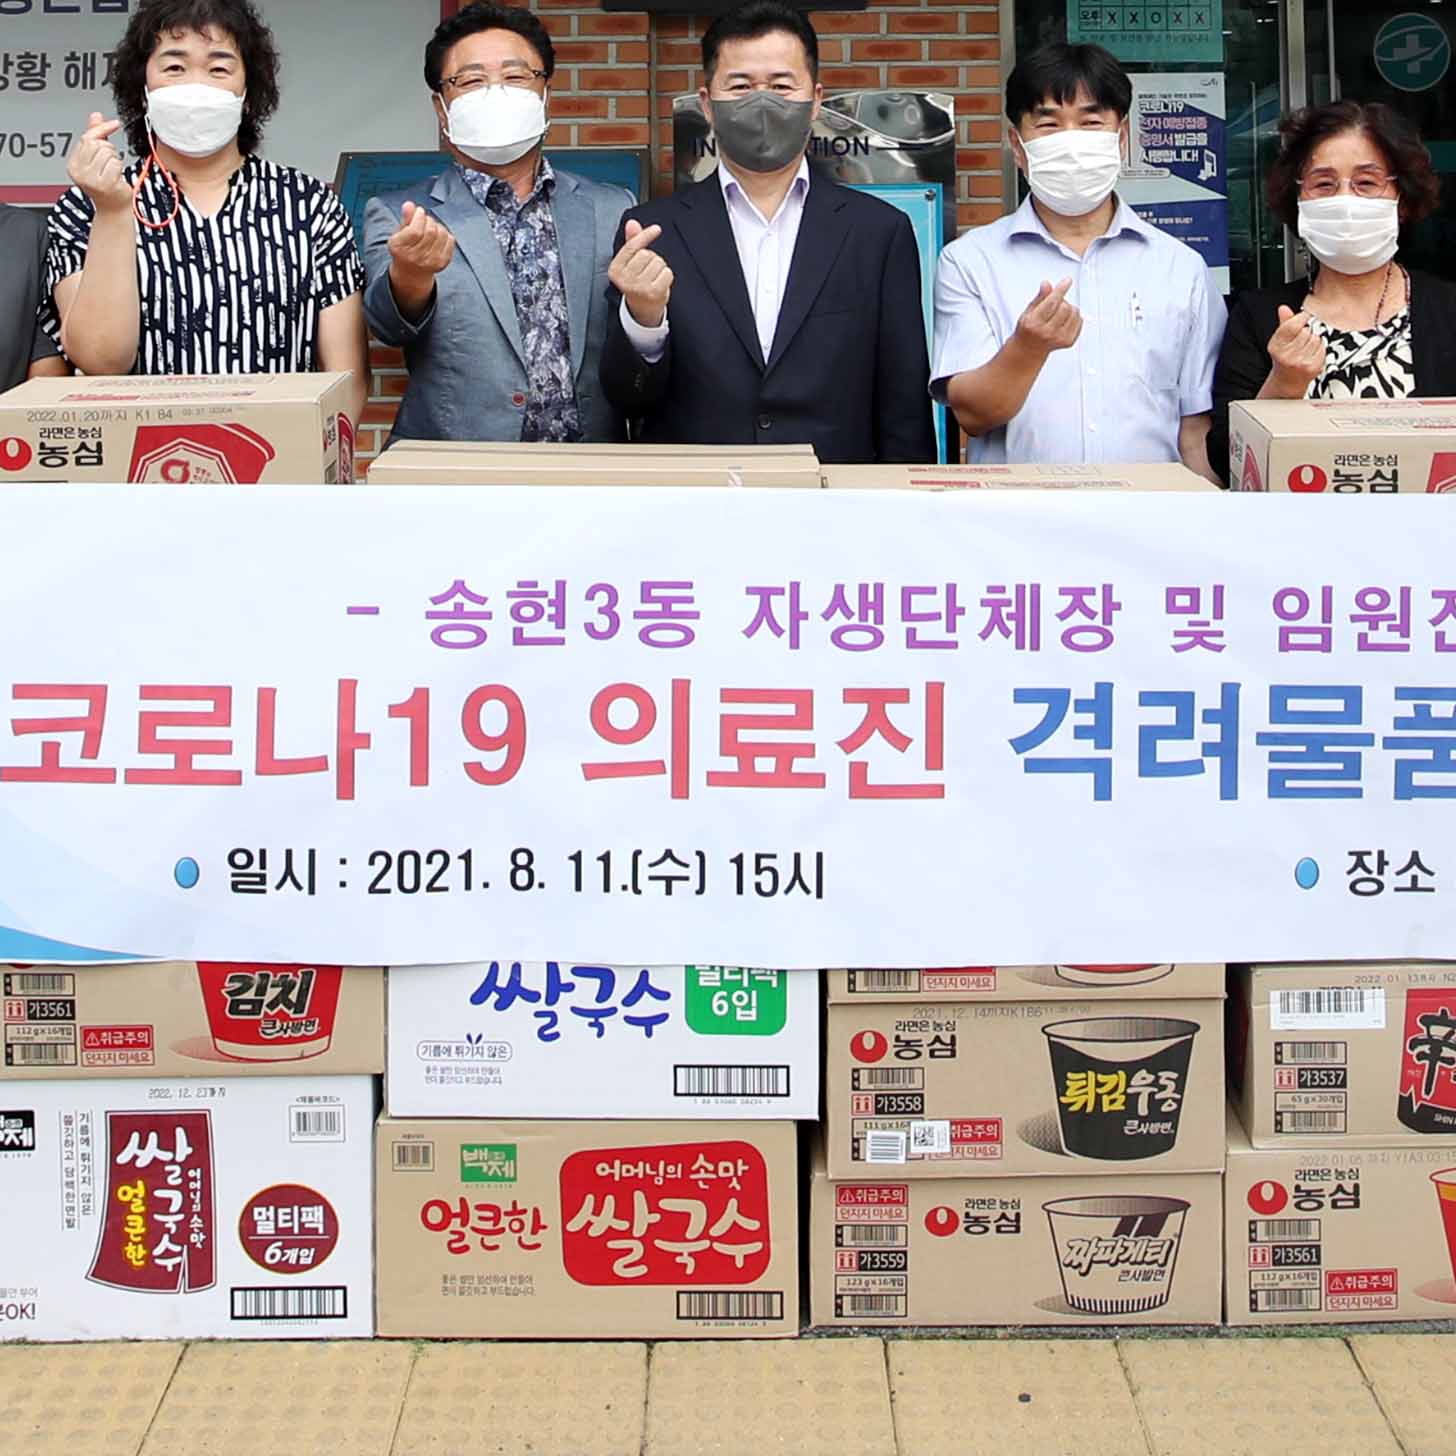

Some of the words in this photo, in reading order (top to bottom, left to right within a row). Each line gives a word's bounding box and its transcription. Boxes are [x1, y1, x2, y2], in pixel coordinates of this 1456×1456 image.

[693, 136, 869, 158] INTION
[37, 440, 104, 468] 농심
[424, 576, 702, 651] 송현3동
[742, 579, 1122, 653] 자생단체장
[1168, 583, 1227, 652] 및
[581, 677, 947, 801] 의료진
[226, 847, 319, 898] 일시
[367, 851, 491, 898] 2021.
[510, 849, 546, 892] 8.
[729, 849, 828, 901] 15시
[1345, 851, 1436, 898] 장소
[29, 1001, 73, 1019] 가3561
[223, 969, 317, 1019] 김치
[470, 961, 672, 1042] 쌀국수
[892, 1033, 957, 1060] 농심
[1060, 1069, 1184, 1114] 튀김우동
[1299, 1068, 1345, 1087] 가3537
[876, 1095, 923, 1113] 가3558
[595, 1159, 682, 1186] 어머님의
[689, 1152, 750, 1191] 손맛
[1292, 1183, 1361, 1212] 농심
[252, 1204, 325, 1236] 멀티팩
[420, 1196, 548, 1256] 얼큰한
[565, 1190, 764, 1278] 쌀국수
[263, 1241, 316, 1265] 6개입
[859, 1252, 906, 1270] 가3559
[1062, 1234, 1177, 1278] 짜파게티
[1273, 1246, 1319, 1265] 가3561
